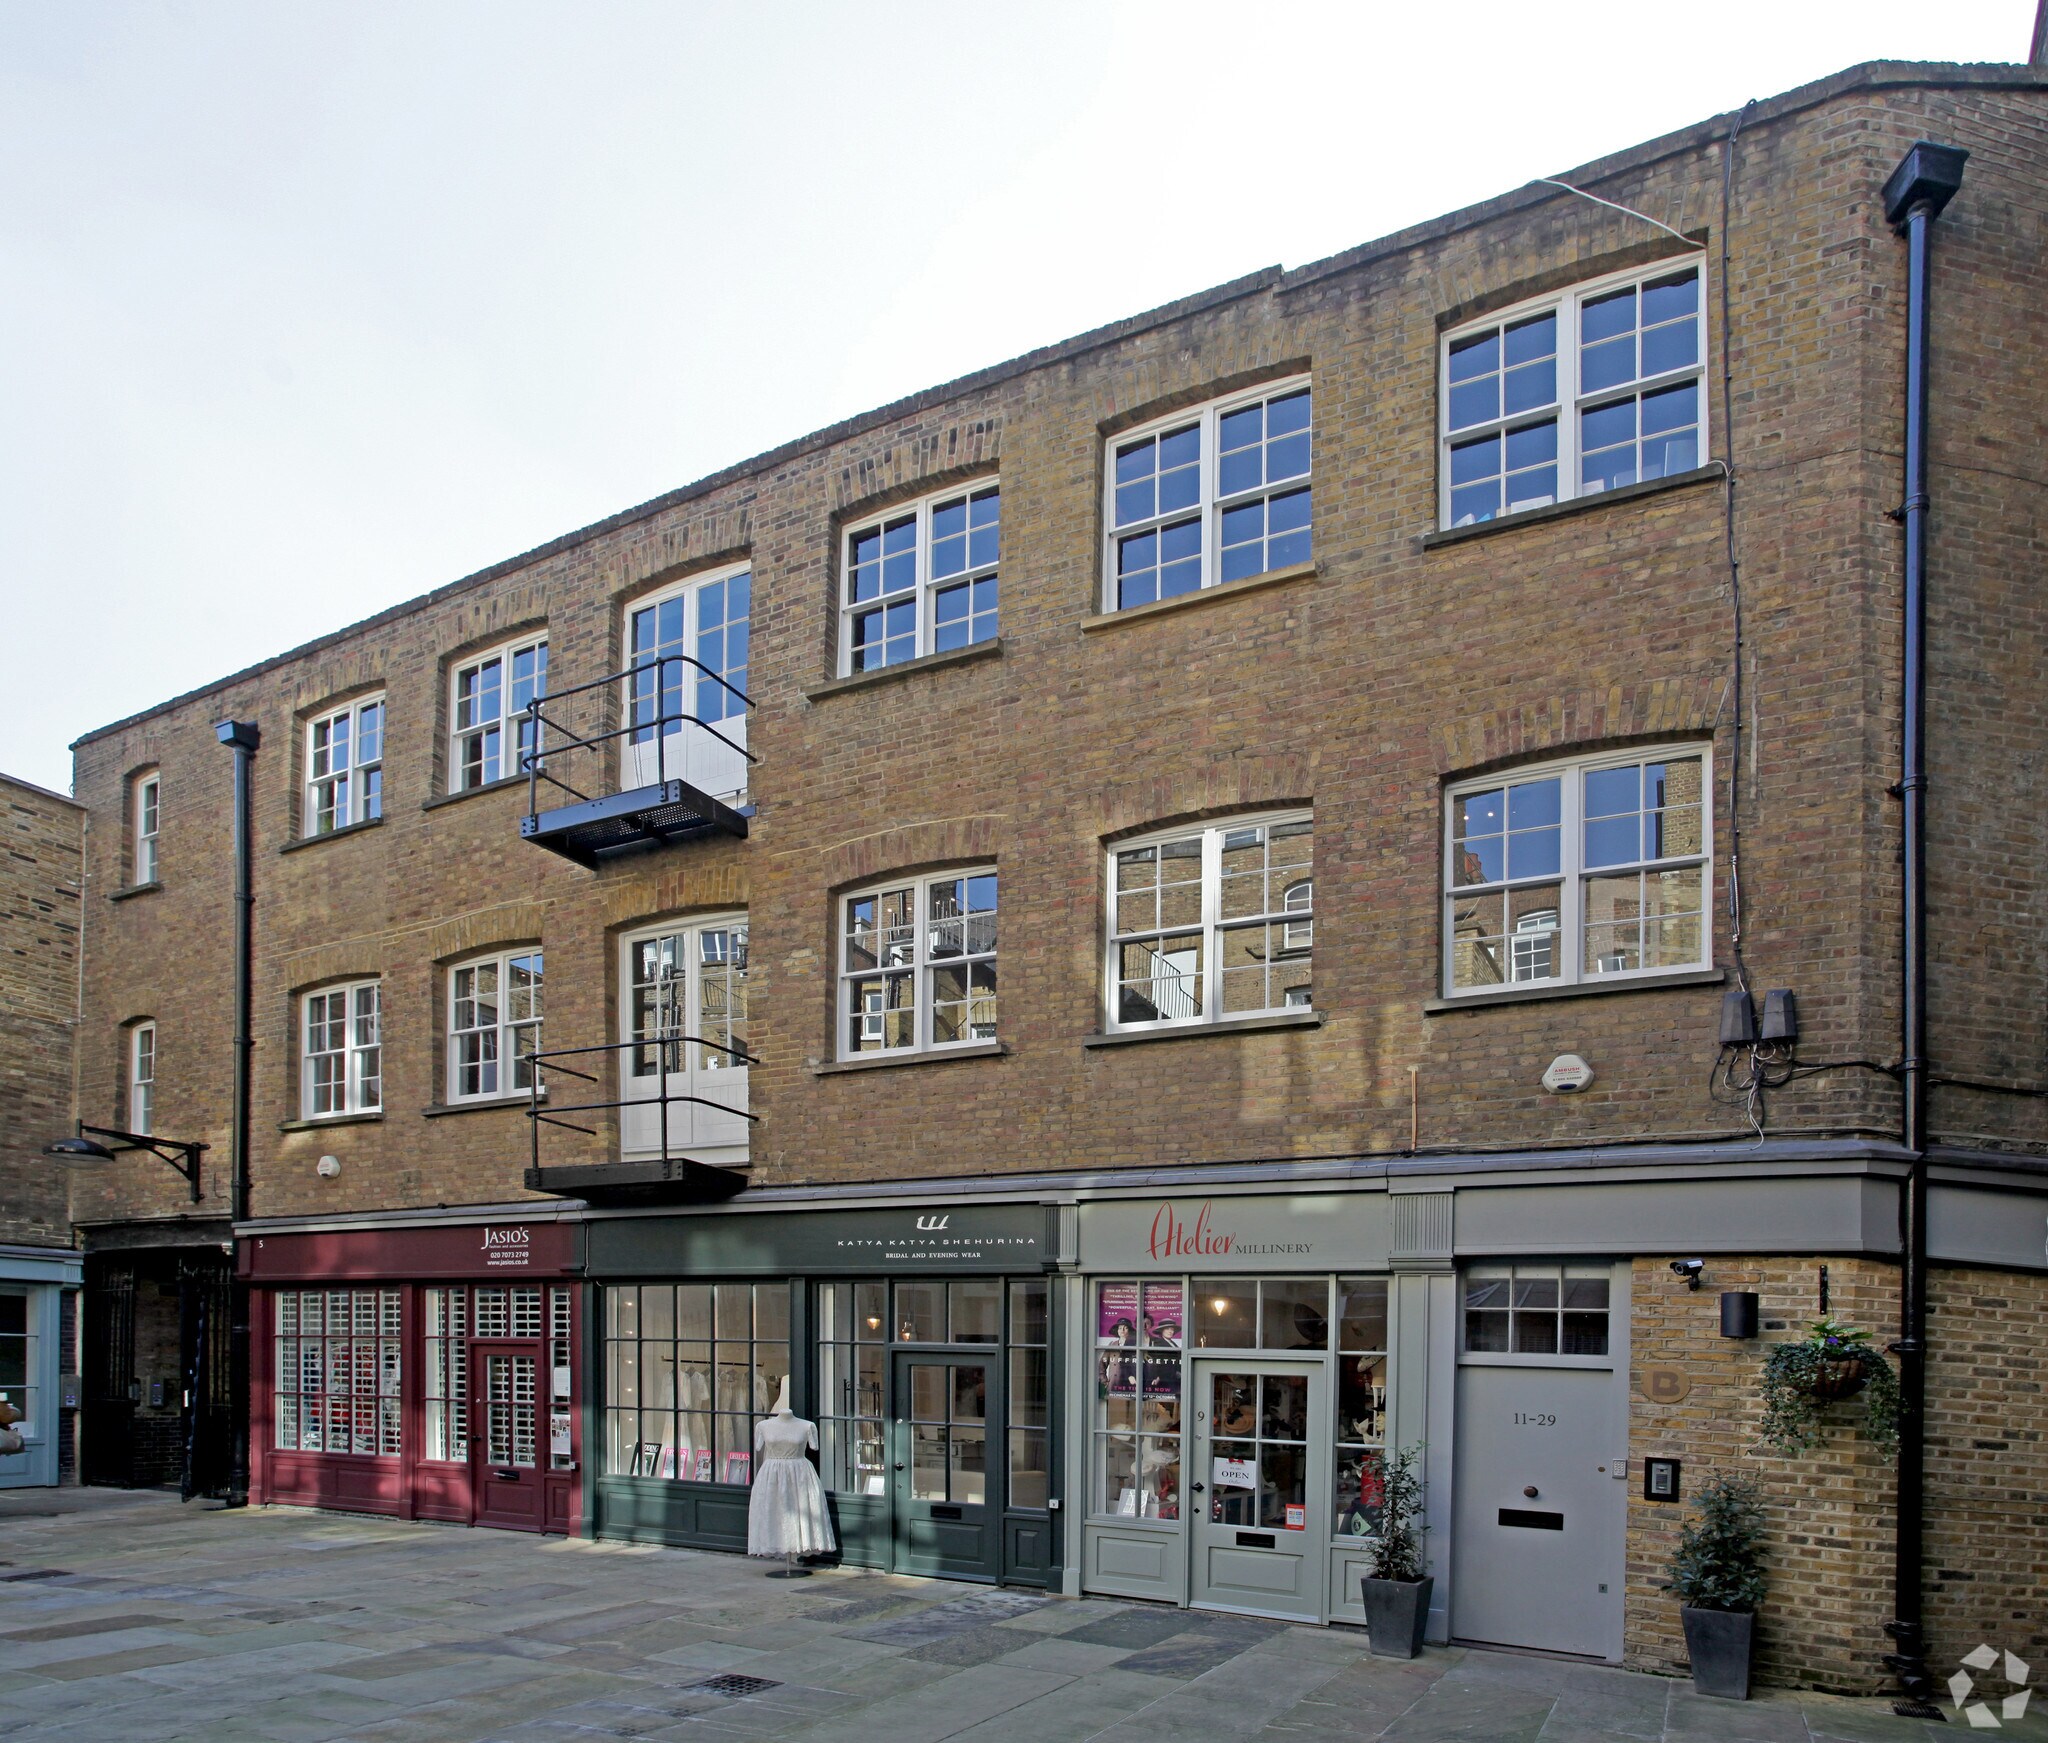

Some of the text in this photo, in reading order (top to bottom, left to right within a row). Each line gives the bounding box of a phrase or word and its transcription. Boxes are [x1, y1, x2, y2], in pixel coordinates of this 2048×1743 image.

[1145, 1200, 1313, 1261] Atelier MILLINERY
[258, 1240, 264, 1248] 5
[1652, 1371, 1680, 1397] B
[1197, 1411, 1205, 1421] 9
[1514, 1413, 1556, 1426] 11-29
[1221, 1470, 1250, 1479] OPEN
